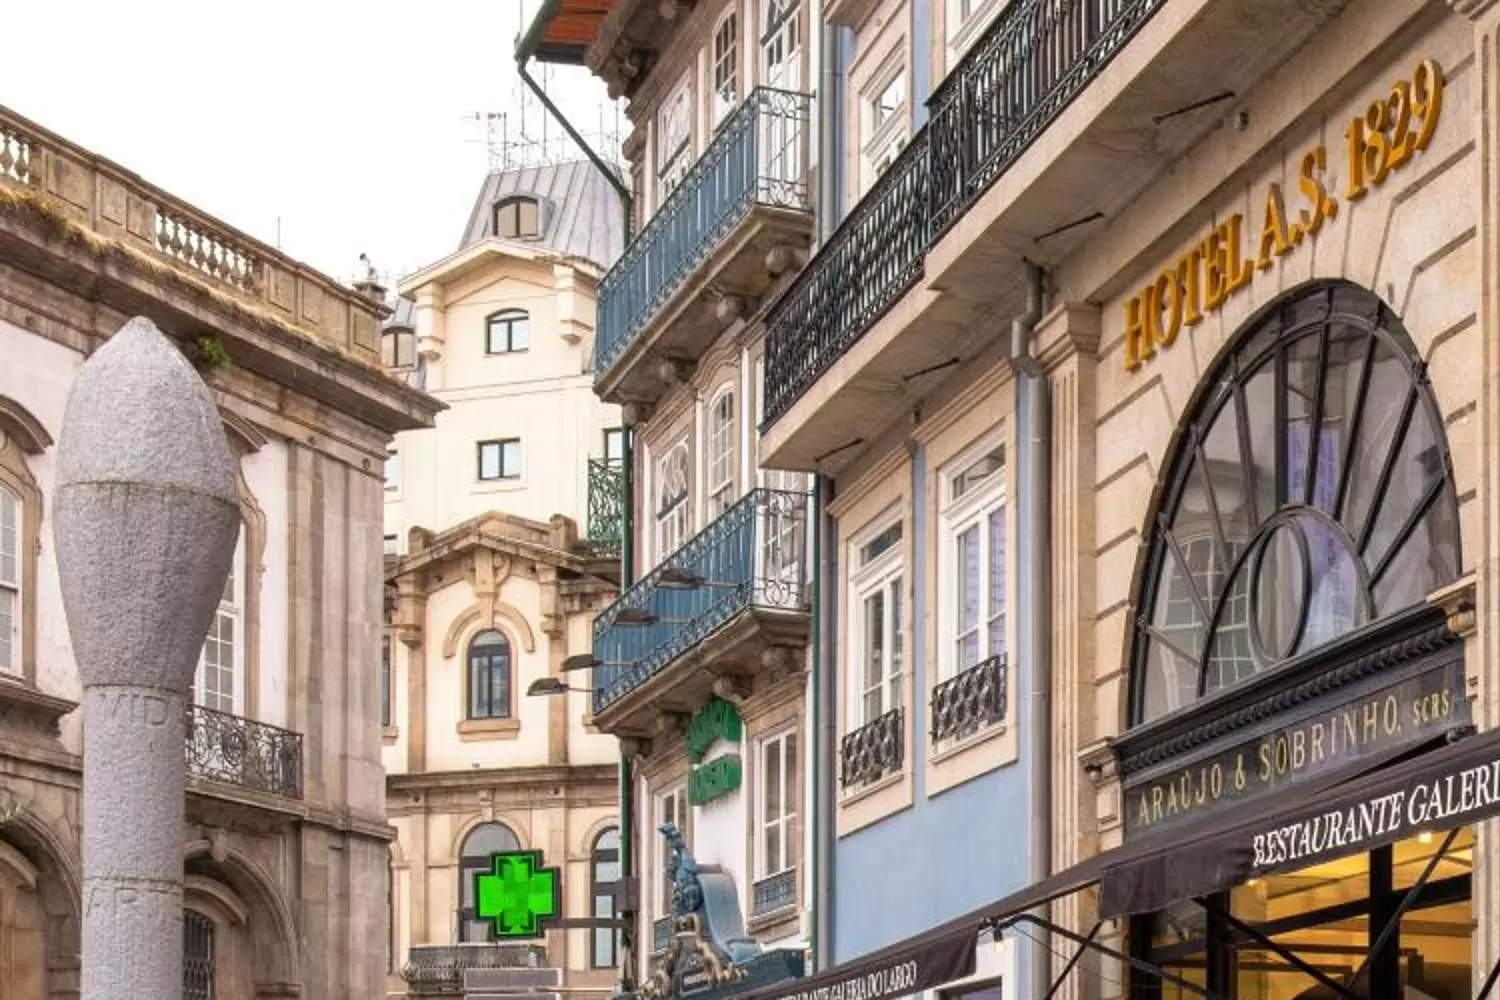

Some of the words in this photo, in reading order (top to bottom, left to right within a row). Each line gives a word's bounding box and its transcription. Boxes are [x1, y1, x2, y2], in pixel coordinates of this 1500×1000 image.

[1123, 213, 1253, 371] HOTEL
[1344, 58, 1444, 202] 1829
[1233, 752, 1247, 791] &
[1253, 791, 1405, 867] RESTAURANTE
[883, 959, 918, 995] LARGO
